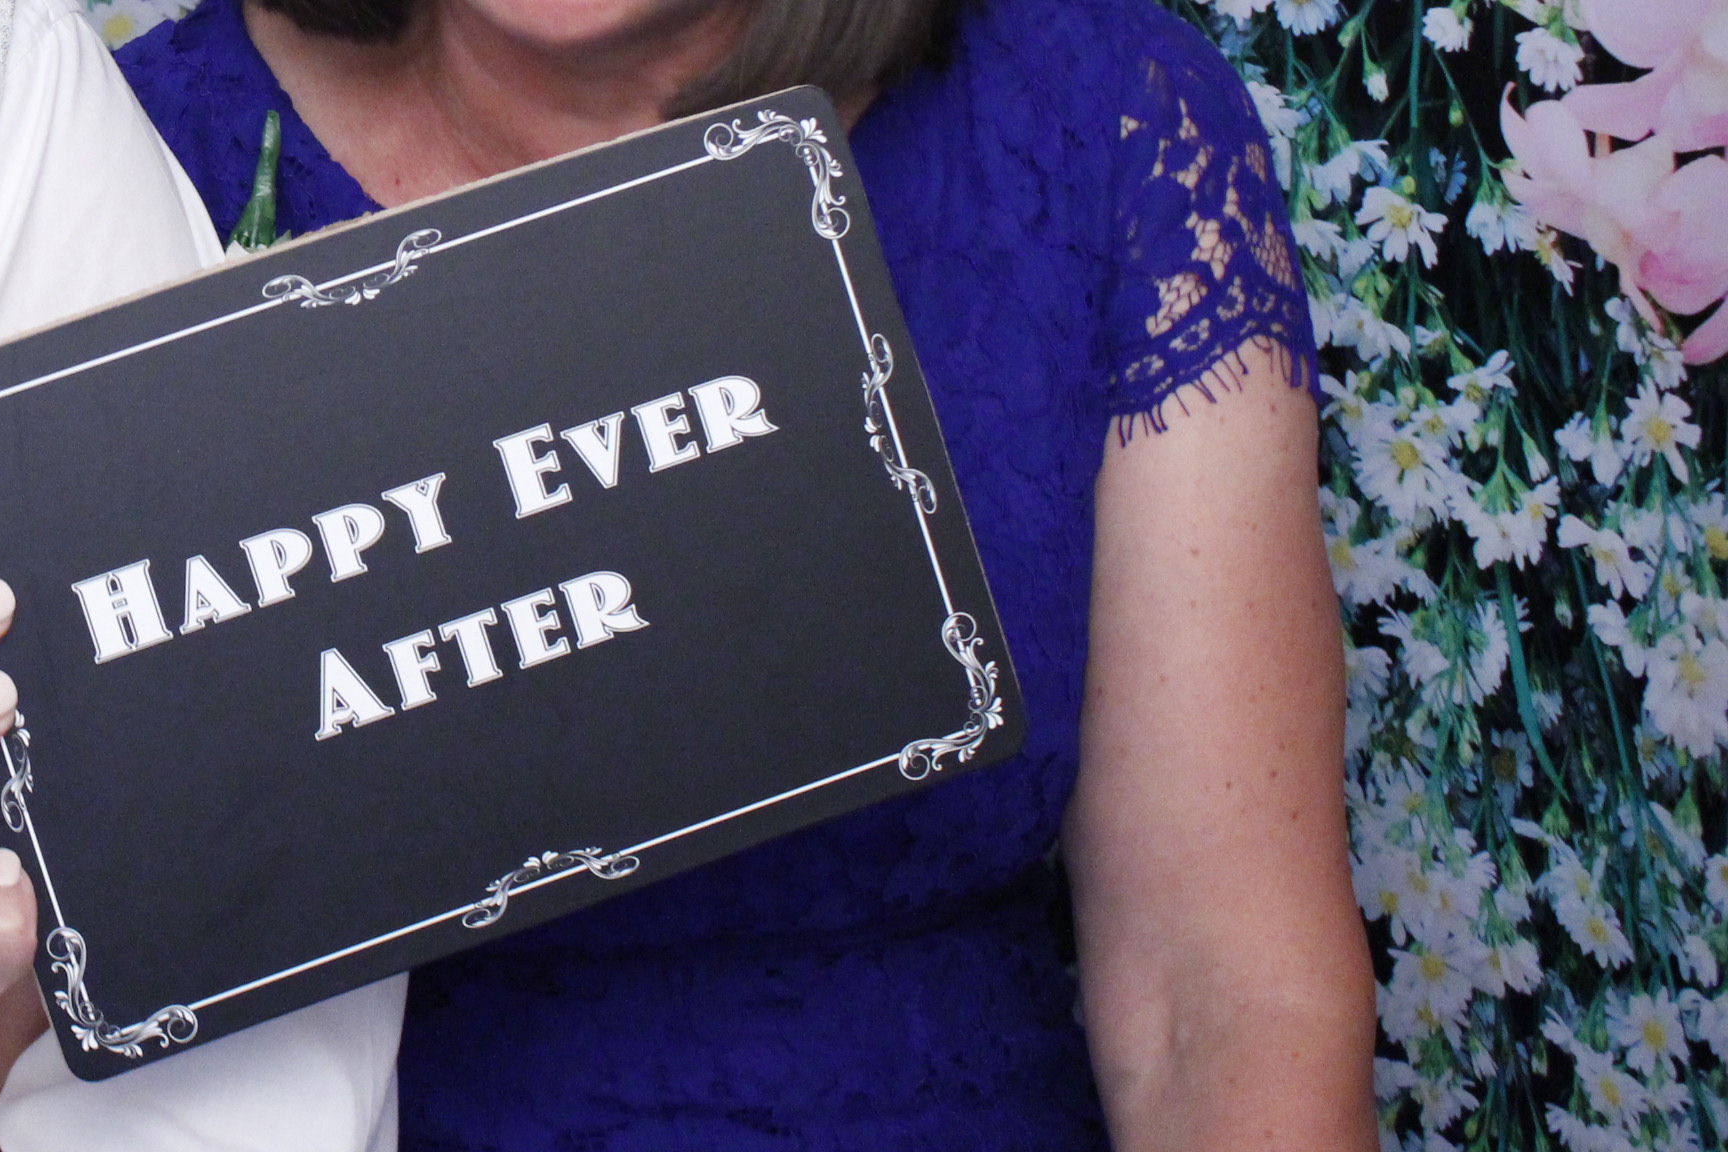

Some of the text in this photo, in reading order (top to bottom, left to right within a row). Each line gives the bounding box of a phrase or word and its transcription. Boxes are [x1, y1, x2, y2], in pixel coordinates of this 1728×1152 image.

[69, 374, 781, 666] HAPPY EVER
[313, 569, 651, 742] AFTER
